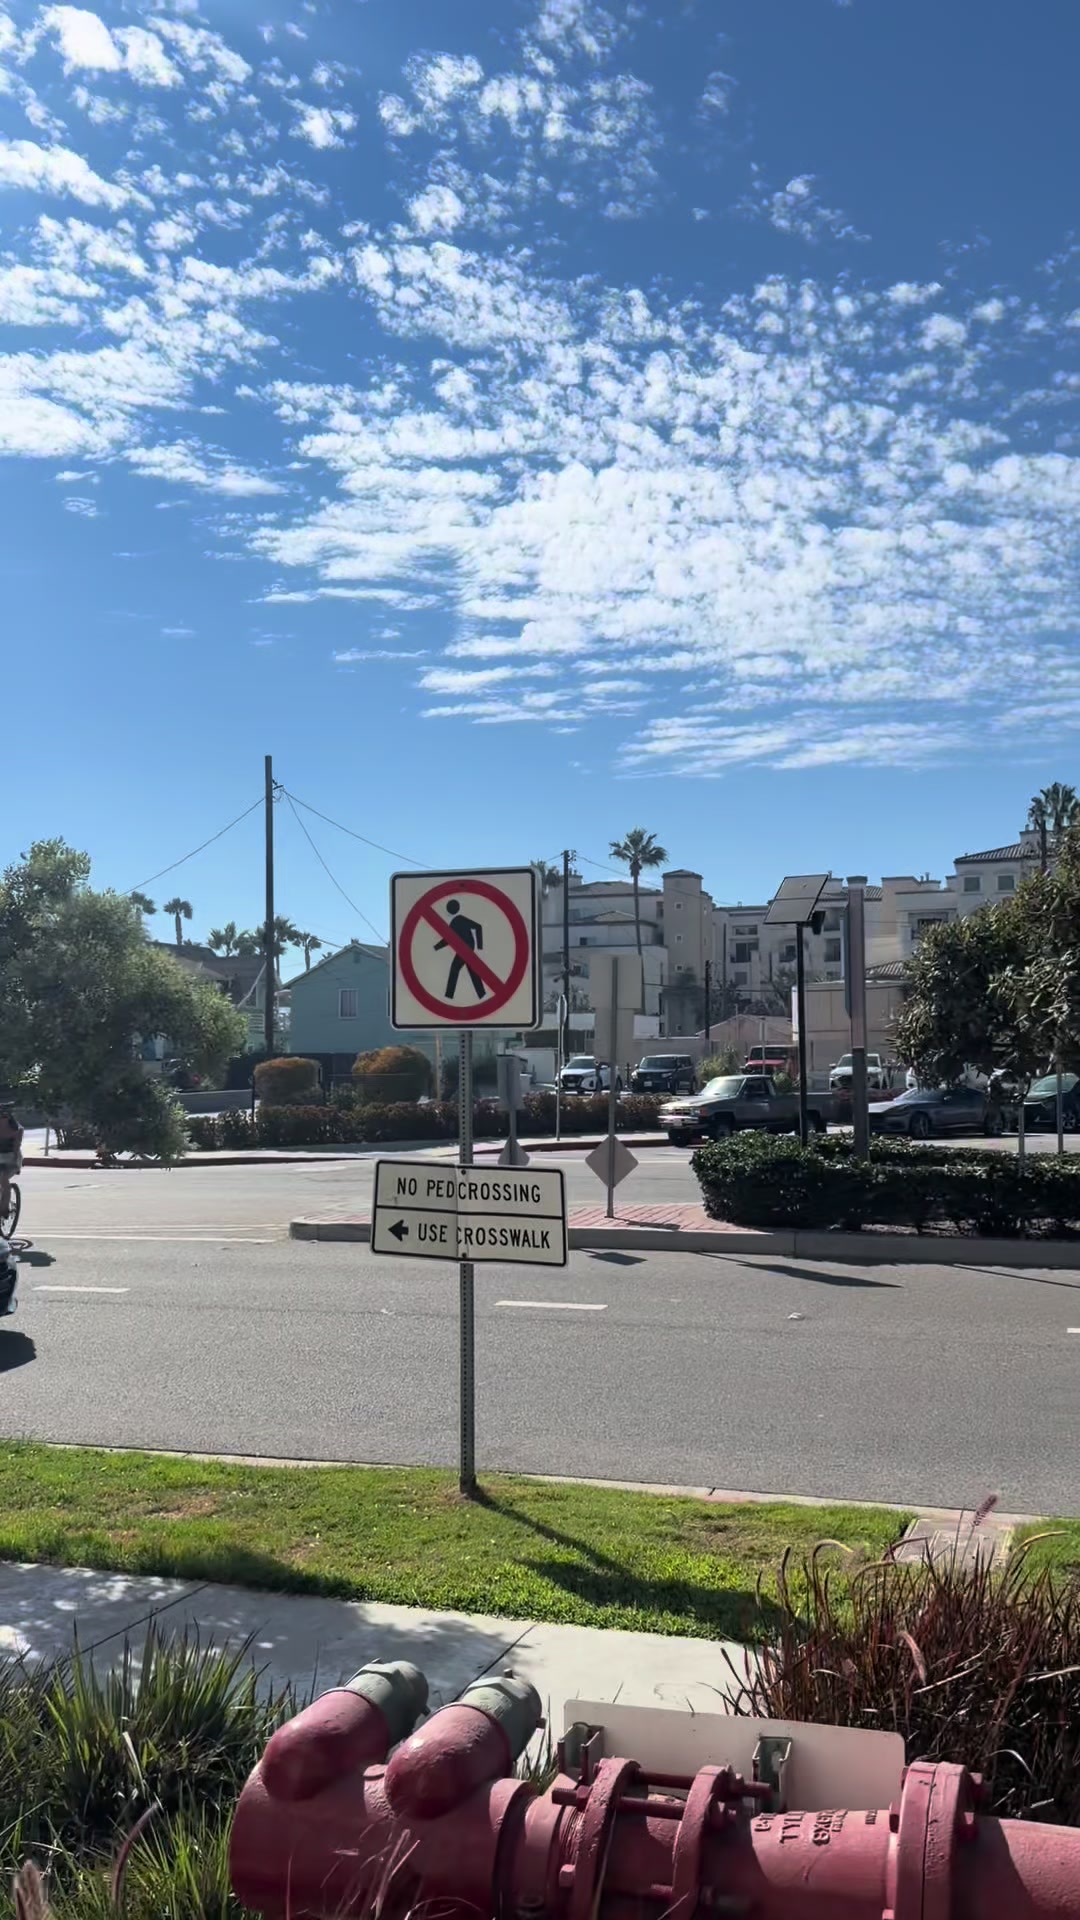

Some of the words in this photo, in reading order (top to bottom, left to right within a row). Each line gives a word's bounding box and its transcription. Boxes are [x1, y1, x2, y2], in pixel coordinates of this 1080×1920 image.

[397, 1177, 418, 1196] NO
[427, 1179, 455, 1199] PED
[458, 1182, 541, 1203] CROSSING
[418, 1223, 448, 1243] USE
[456, 1226, 550, 1250] CROSSWALK
